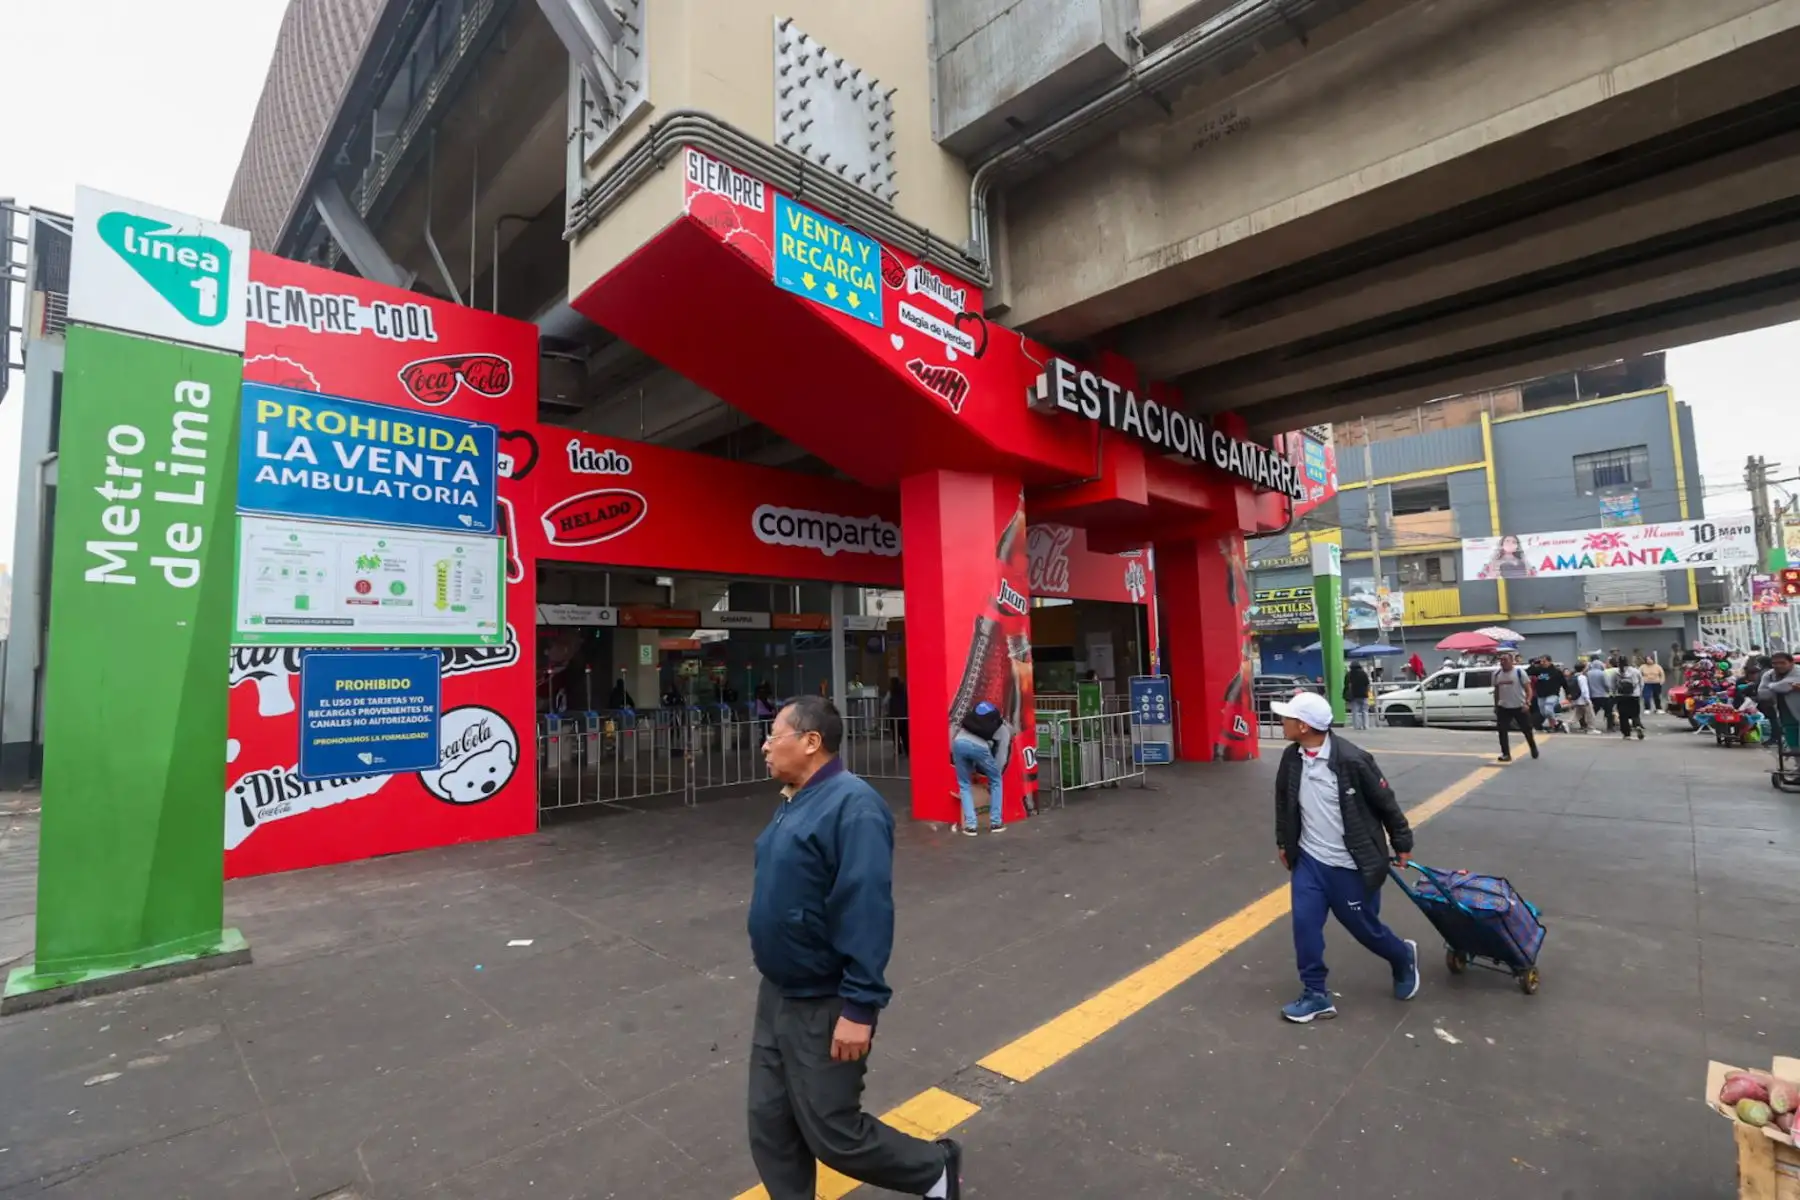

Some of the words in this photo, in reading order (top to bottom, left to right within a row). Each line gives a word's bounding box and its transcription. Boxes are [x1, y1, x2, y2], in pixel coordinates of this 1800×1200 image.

[688, 152, 763, 210] SIEMPRE
[786, 206, 854, 260] VENTA
[857, 241, 871, 265] Y
[782, 232, 877, 295] RECARGA
[190, 276, 218, 317] 1
[374, 303, 435, 339] COOL
[901, 308, 930, 329] Magia
[930, 323, 942, 336] de
[943, 327, 972, 350] Verdad
[154, 380, 211, 505] Lima
[257, 399, 480, 457] PROHIBIDA
[1055, 357, 1206, 461] ESTACION
[1212, 430, 1303, 497] GAMARRA
[256, 430, 319, 465] LA
[332, 441, 480, 486] VENTA
[570, 440, 630, 474] Ídolo
[85, 424, 146, 585] Metro
[255, 465, 479, 508] AMBULATORIA
[560, 501, 632, 532] HELADO
[758, 512, 897, 550] comparte
[1690, 523, 1716, 544] 10
[1718, 525, 1751, 537] MAYO
[150, 522, 203, 588] de
[1539, 547, 1680, 572] AMARANTA
[999, 581, 1026, 613] Juan
[1261, 602, 1312, 614] TEXTILES
[319, 699, 331, 708] EL
[332, 698, 352, 707] USO
[353, 698, 365, 706] DE
[367, 696, 408, 706] TARJETAS
[408, 696, 425, 704] Y/O
[335, 678, 412, 692] PROHIBIDO
[308, 708, 357, 719] RECARGAS
[358, 706, 421, 717] PROVENIENTES
[422, 705, 434, 713] DE
[310, 718, 352, 729] CANALES
[353, 718, 367, 727] NO
[368, 715, 432, 726] AUTORIZADOS.
